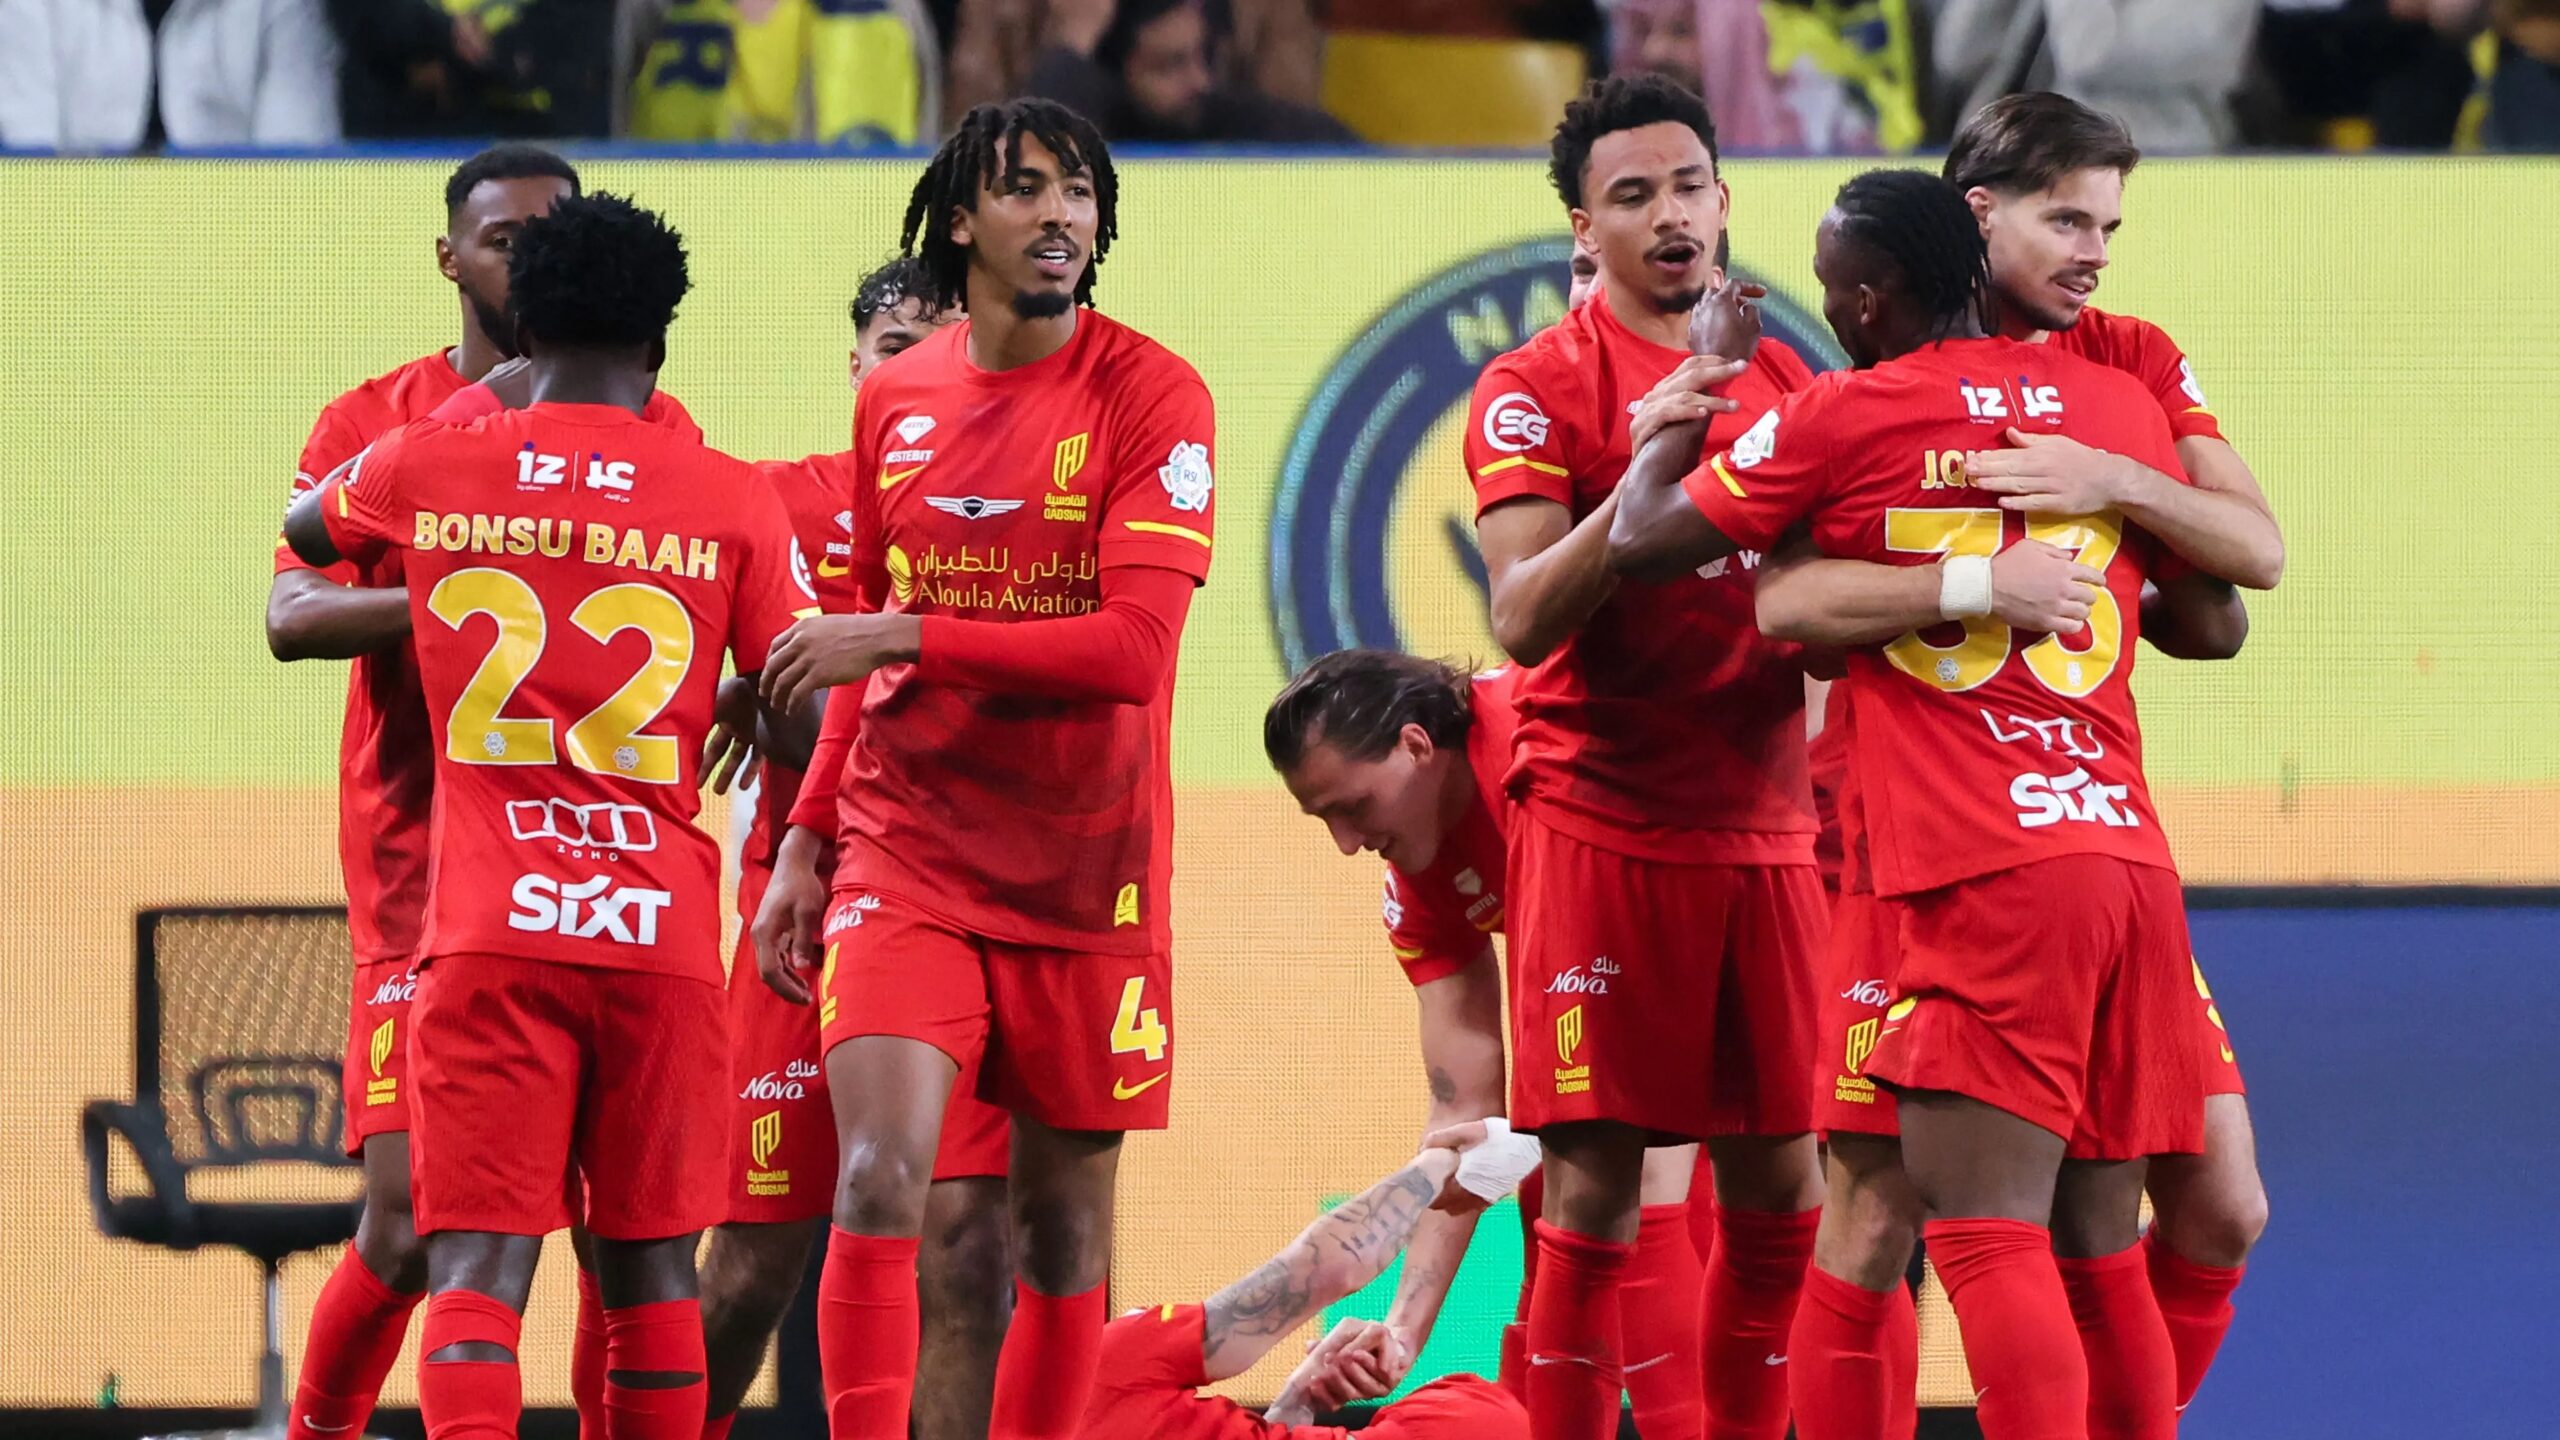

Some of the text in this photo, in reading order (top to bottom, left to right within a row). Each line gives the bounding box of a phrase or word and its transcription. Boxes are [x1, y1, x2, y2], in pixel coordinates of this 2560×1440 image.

[413, 511, 719, 581] BONSU BAAH
[916, 543, 1009, 578] للطيران
[916, 580, 1100, 615] Aloula Aviation
[426, 566, 695, 785] 22
[557, 843, 619, 863] ZOHO
[1840, 979, 1890, 1008] Nov
[1110, 975, 1169, 1062] 4
